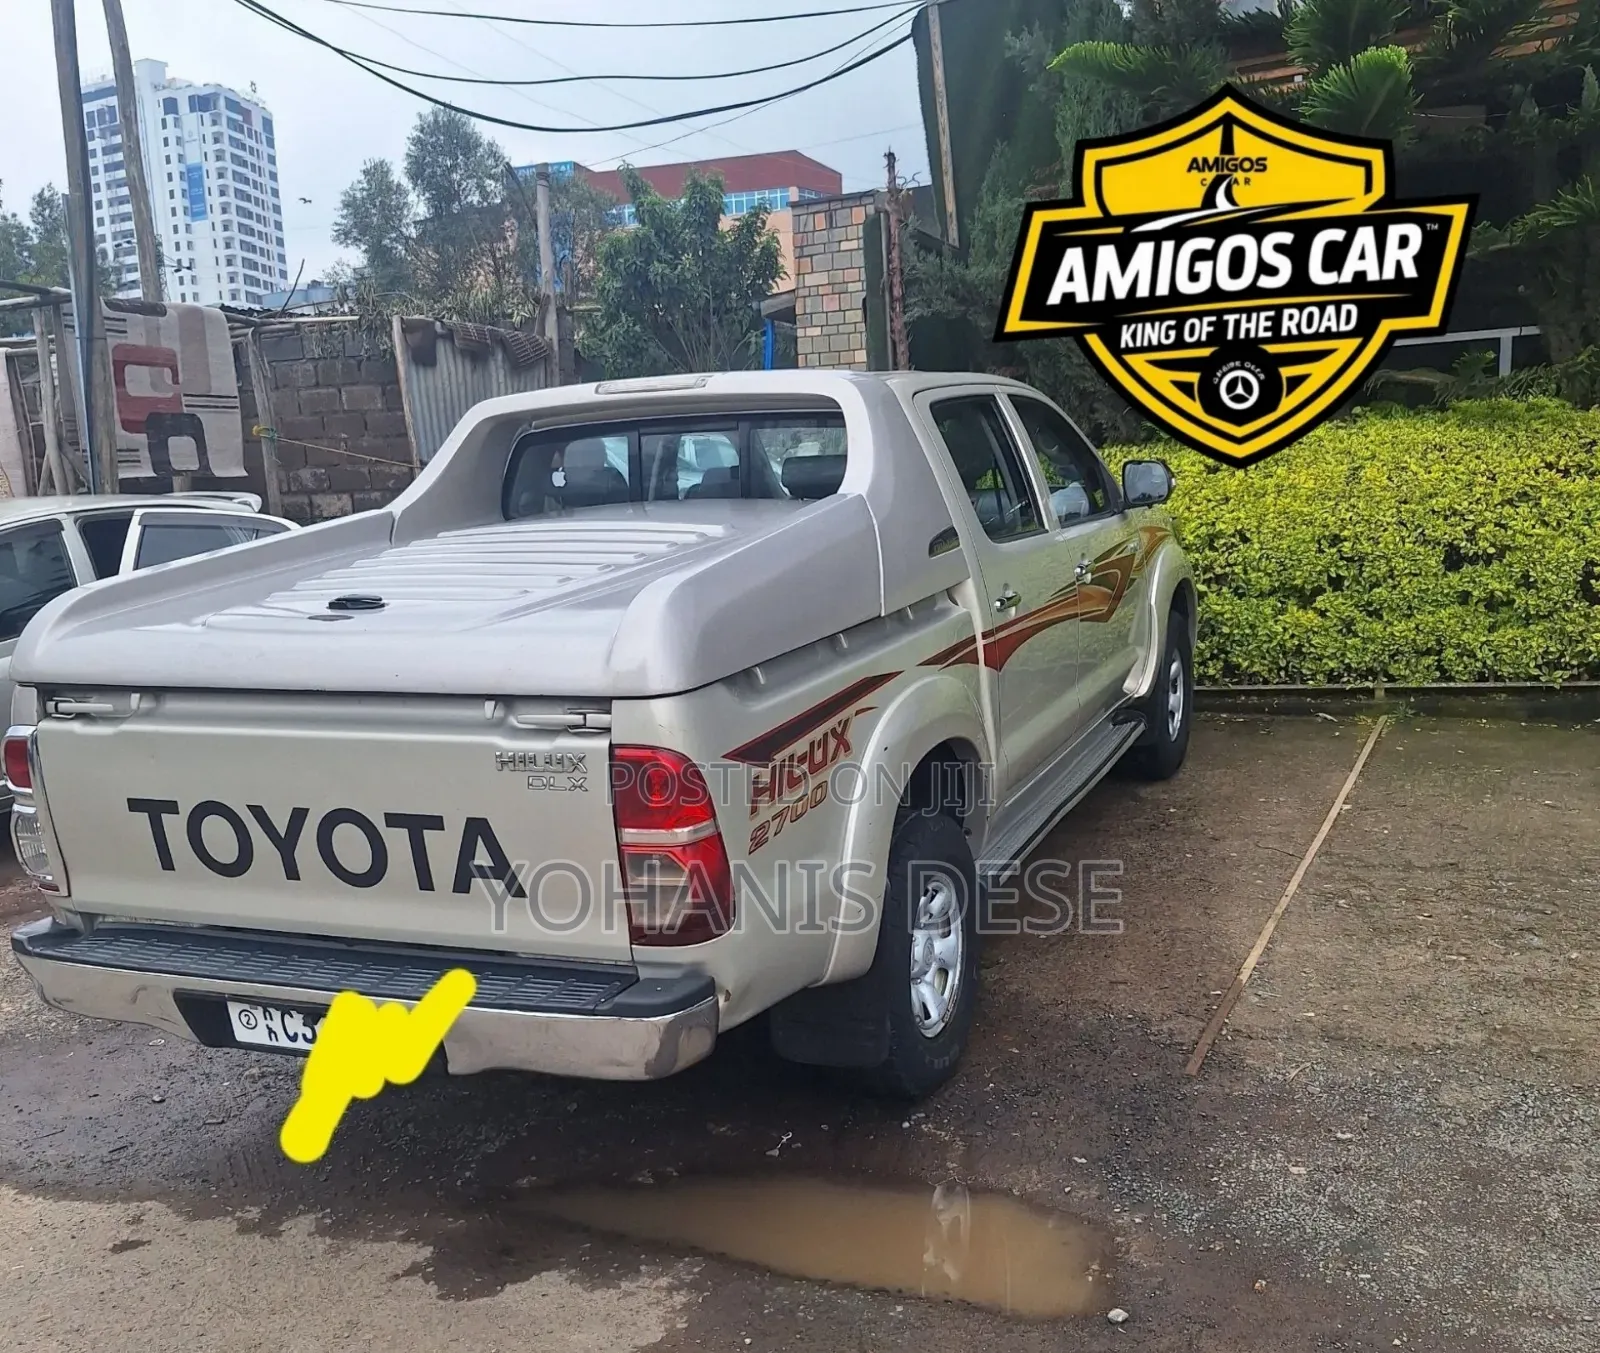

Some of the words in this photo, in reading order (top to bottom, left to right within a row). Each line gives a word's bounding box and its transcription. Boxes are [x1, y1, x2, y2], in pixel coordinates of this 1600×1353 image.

[495, 751, 588, 773] HILUX
[527, 775, 589, 792] DLX
[748, 780, 828, 855] 2700
[127, 797, 527, 898] TOYOTA
